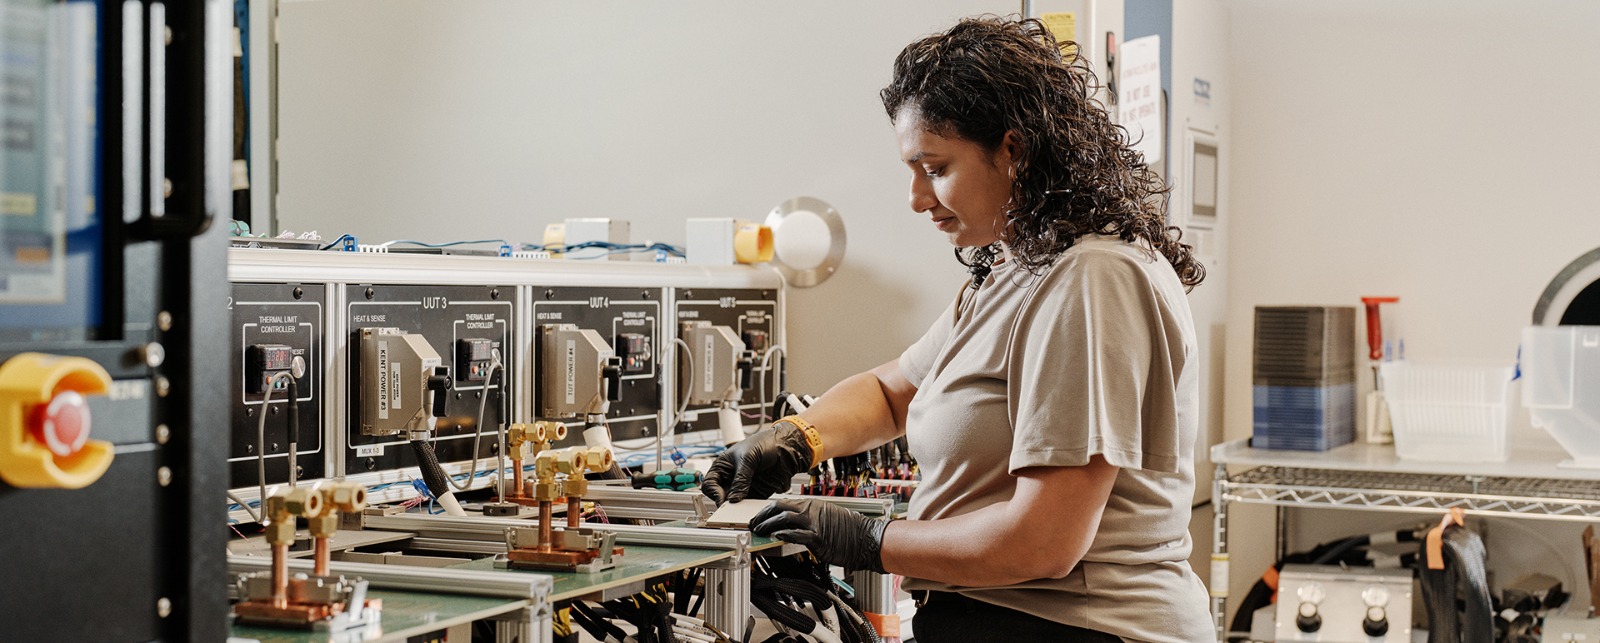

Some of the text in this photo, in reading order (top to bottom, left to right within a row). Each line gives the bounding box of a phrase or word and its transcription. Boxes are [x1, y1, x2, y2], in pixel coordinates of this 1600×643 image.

[227, 296, 233, 310] 2
[423, 296, 447, 309] UUT 3
[589, 296, 609, 308] UUT 4
[259, 315, 298, 324] THERMAL LIMIT
[370, 314, 386, 322] SENSE
[465, 313, 484, 321] THERMAL
[260, 325, 296, 333] CONTROLLER
[467, 321, 493, 329] CONTROLLER
[380, 401, 386, 411] #3
